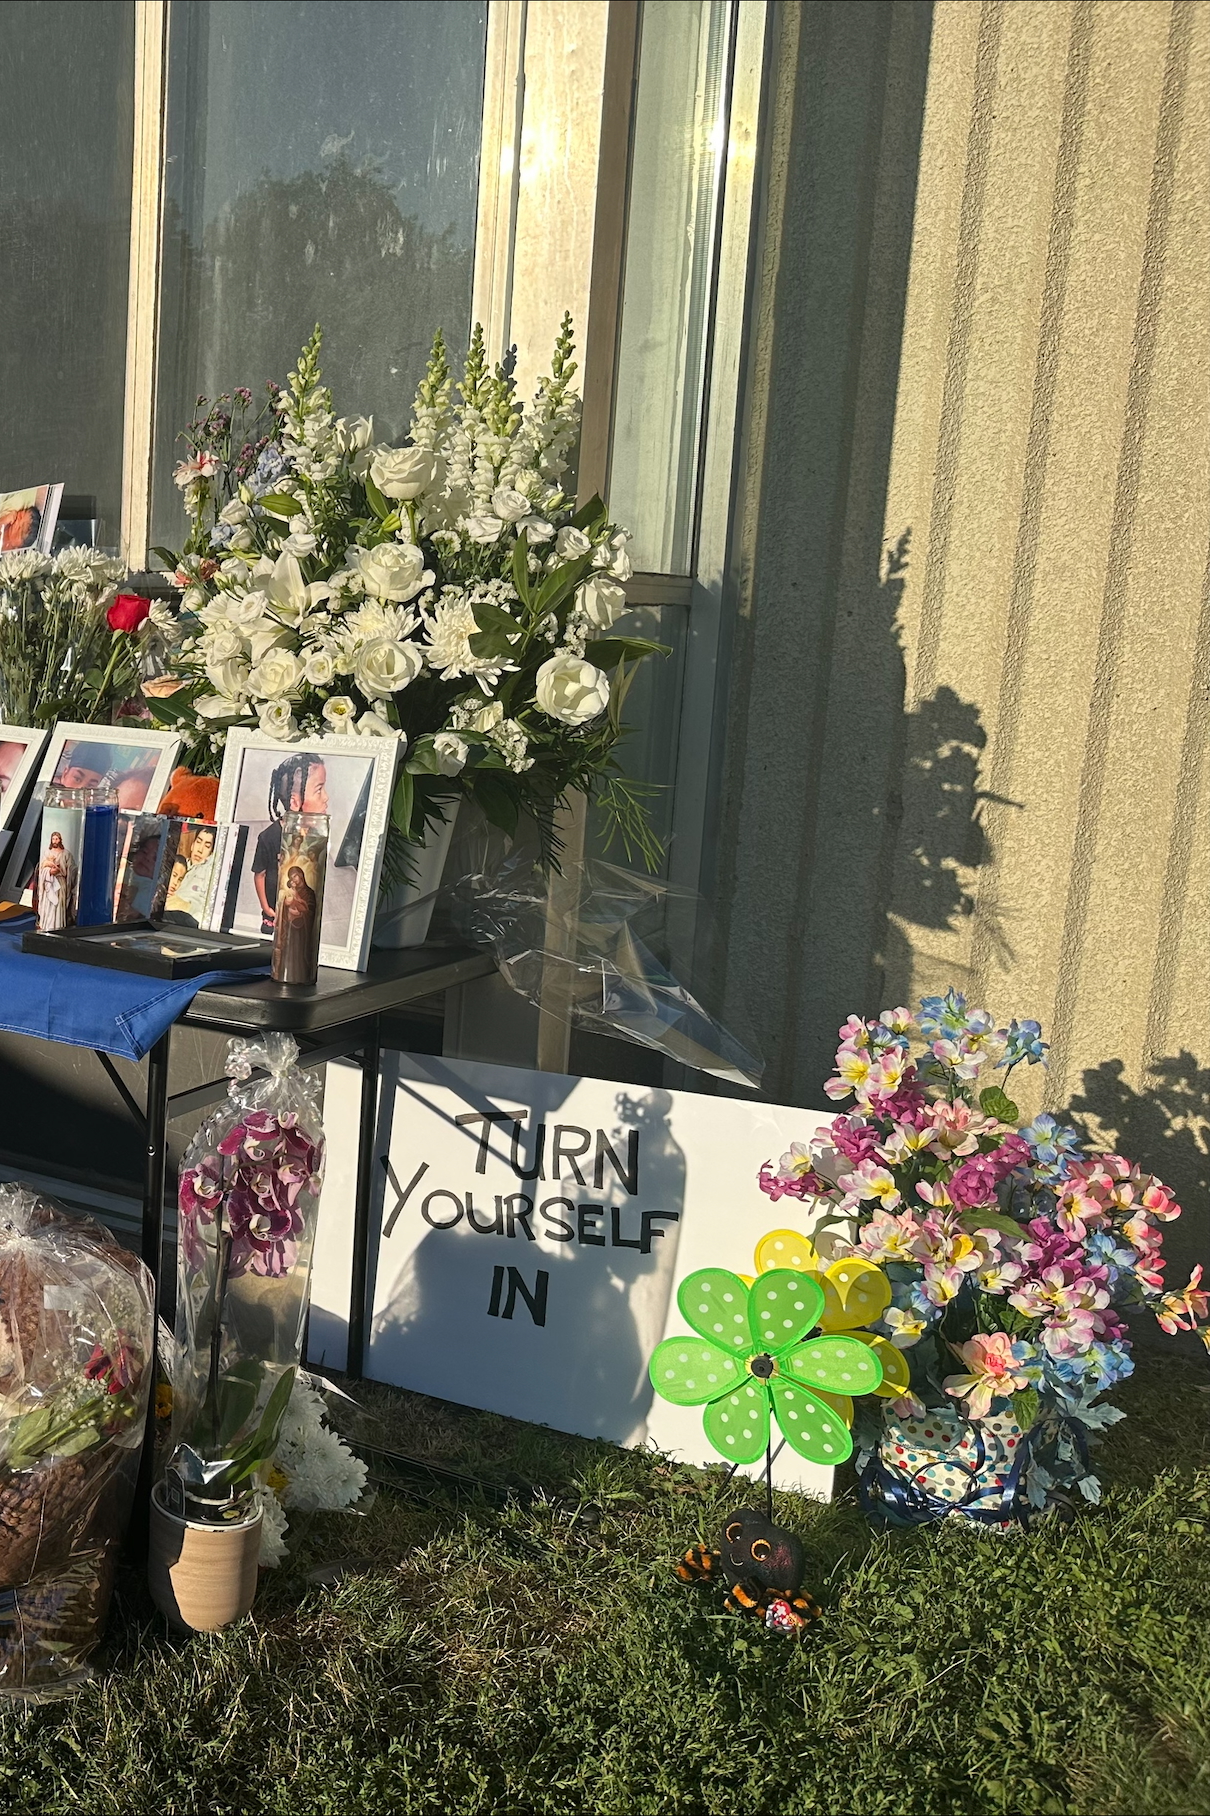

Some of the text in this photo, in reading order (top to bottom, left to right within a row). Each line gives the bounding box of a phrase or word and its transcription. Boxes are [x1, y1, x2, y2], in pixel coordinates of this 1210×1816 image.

[455, 1109, 640, 1196] TURN
[380, 1155, 680, 1254] YOURSELF
[486, 1265, 550, 1327] IN
